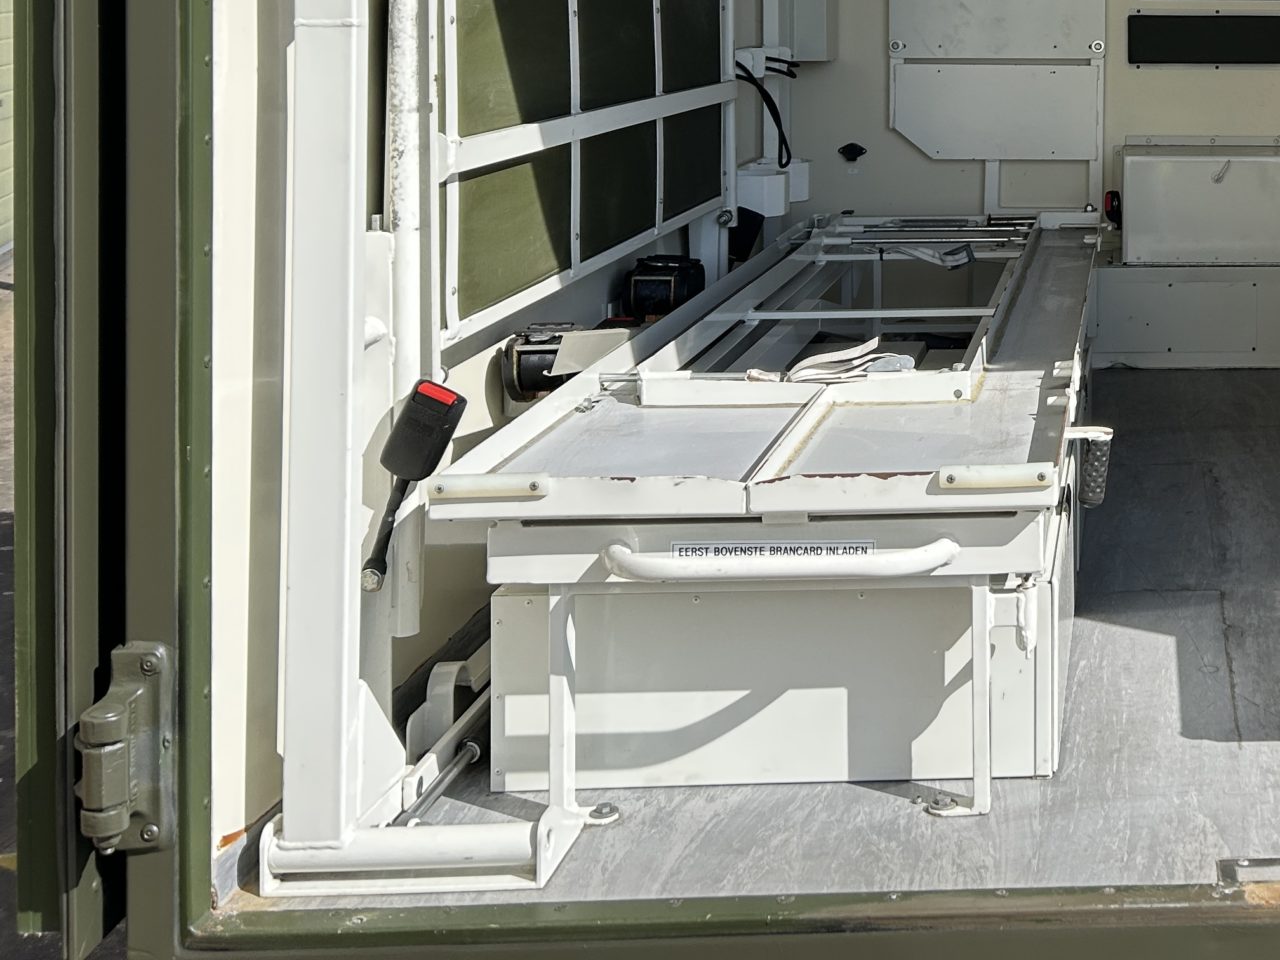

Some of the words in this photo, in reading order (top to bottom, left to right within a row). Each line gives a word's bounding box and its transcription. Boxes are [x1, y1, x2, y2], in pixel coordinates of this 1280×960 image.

[678, 546, 710, 557] EERST
[713, 546, 766, 557] BOVENSTE
[769, 545, 823, 556] BRANCARD
[825, 545, 868, 555] INLADEN
